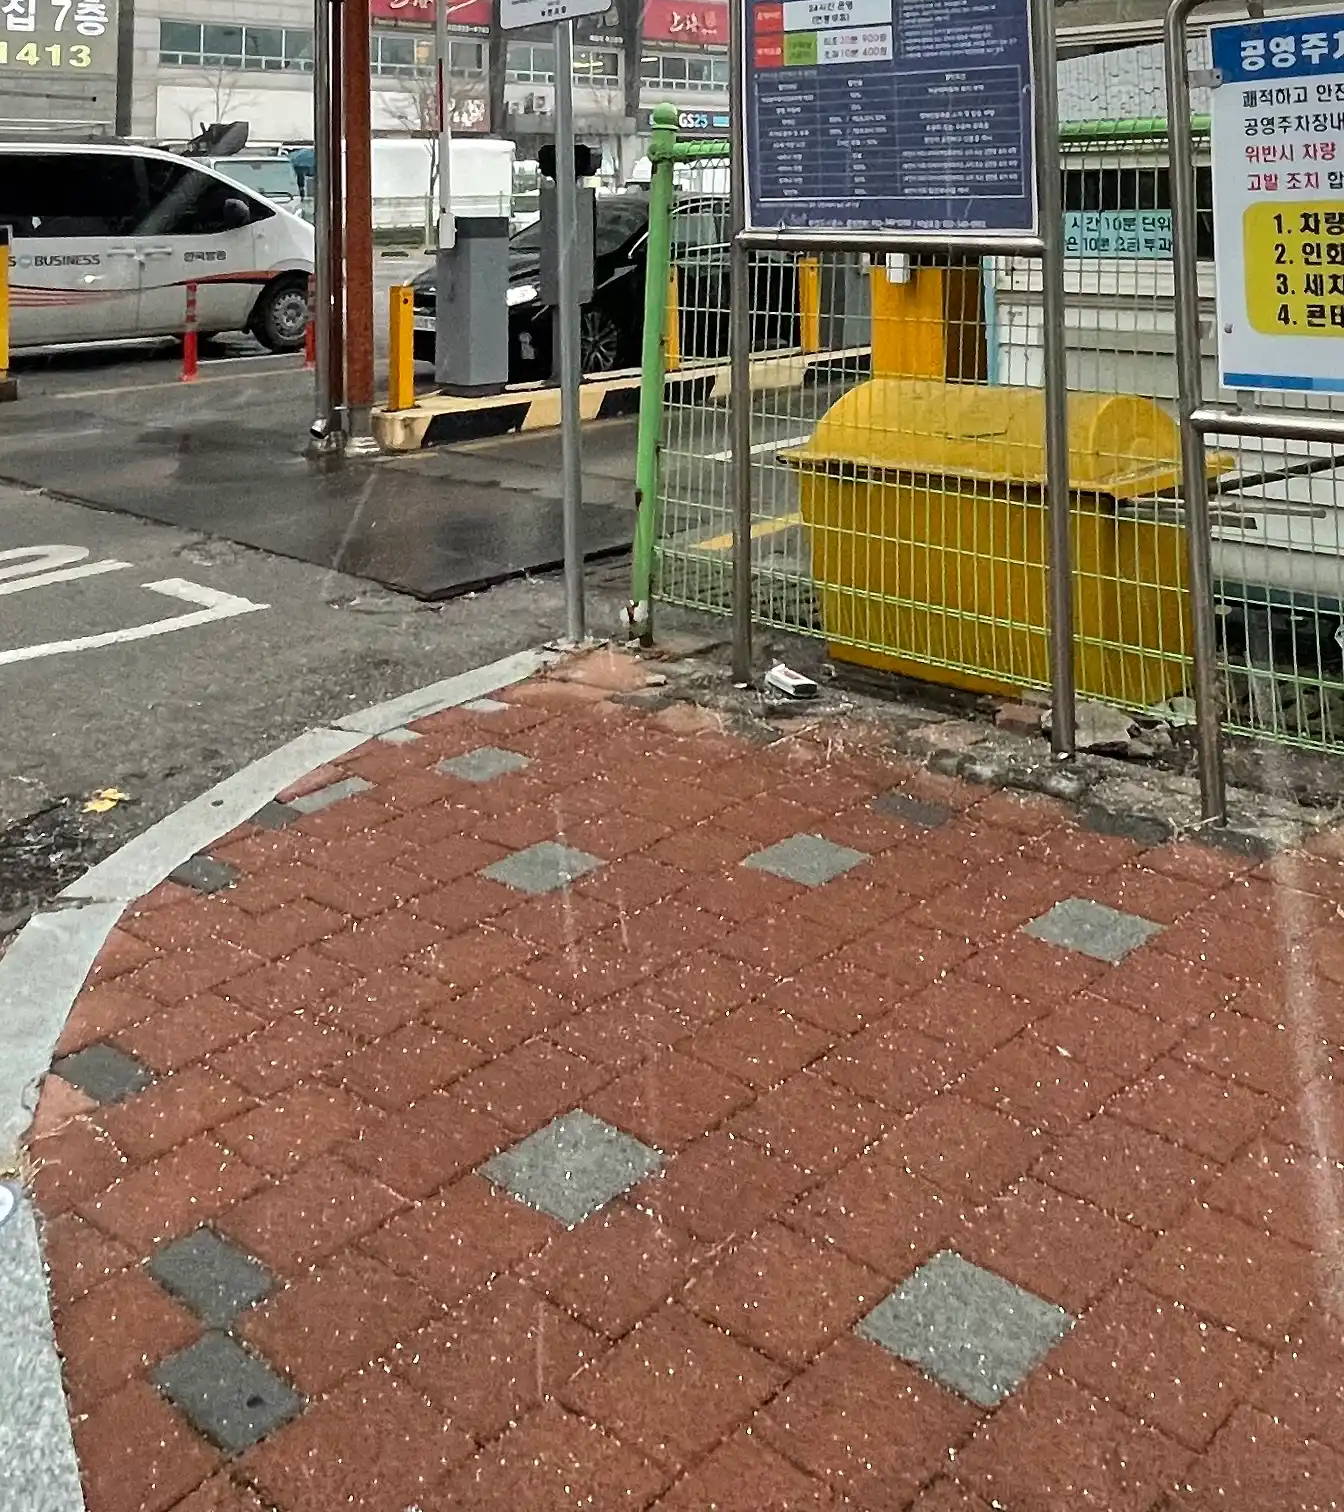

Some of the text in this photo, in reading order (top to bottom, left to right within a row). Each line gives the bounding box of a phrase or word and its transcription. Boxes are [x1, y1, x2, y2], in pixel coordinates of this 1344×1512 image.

[678, 112, 709, 129] GS25
[1245, 143, 1294, 164] 위반시
[1302, 141, 1336, 161] 차량
[1247, 172, 1279, 191] 고발
[1286, 171, 1320, 190] 조치
[1141, 216, 1172, 232] 단위
[1272, 213, 1293, 235] 1.
[34, 254, 101, 267] BUSINESS
[1274, 242, 1294, 265] 2.
[1276, 273, 1296, 295] 3.
[1277, 304, 1297, 326] 4.
